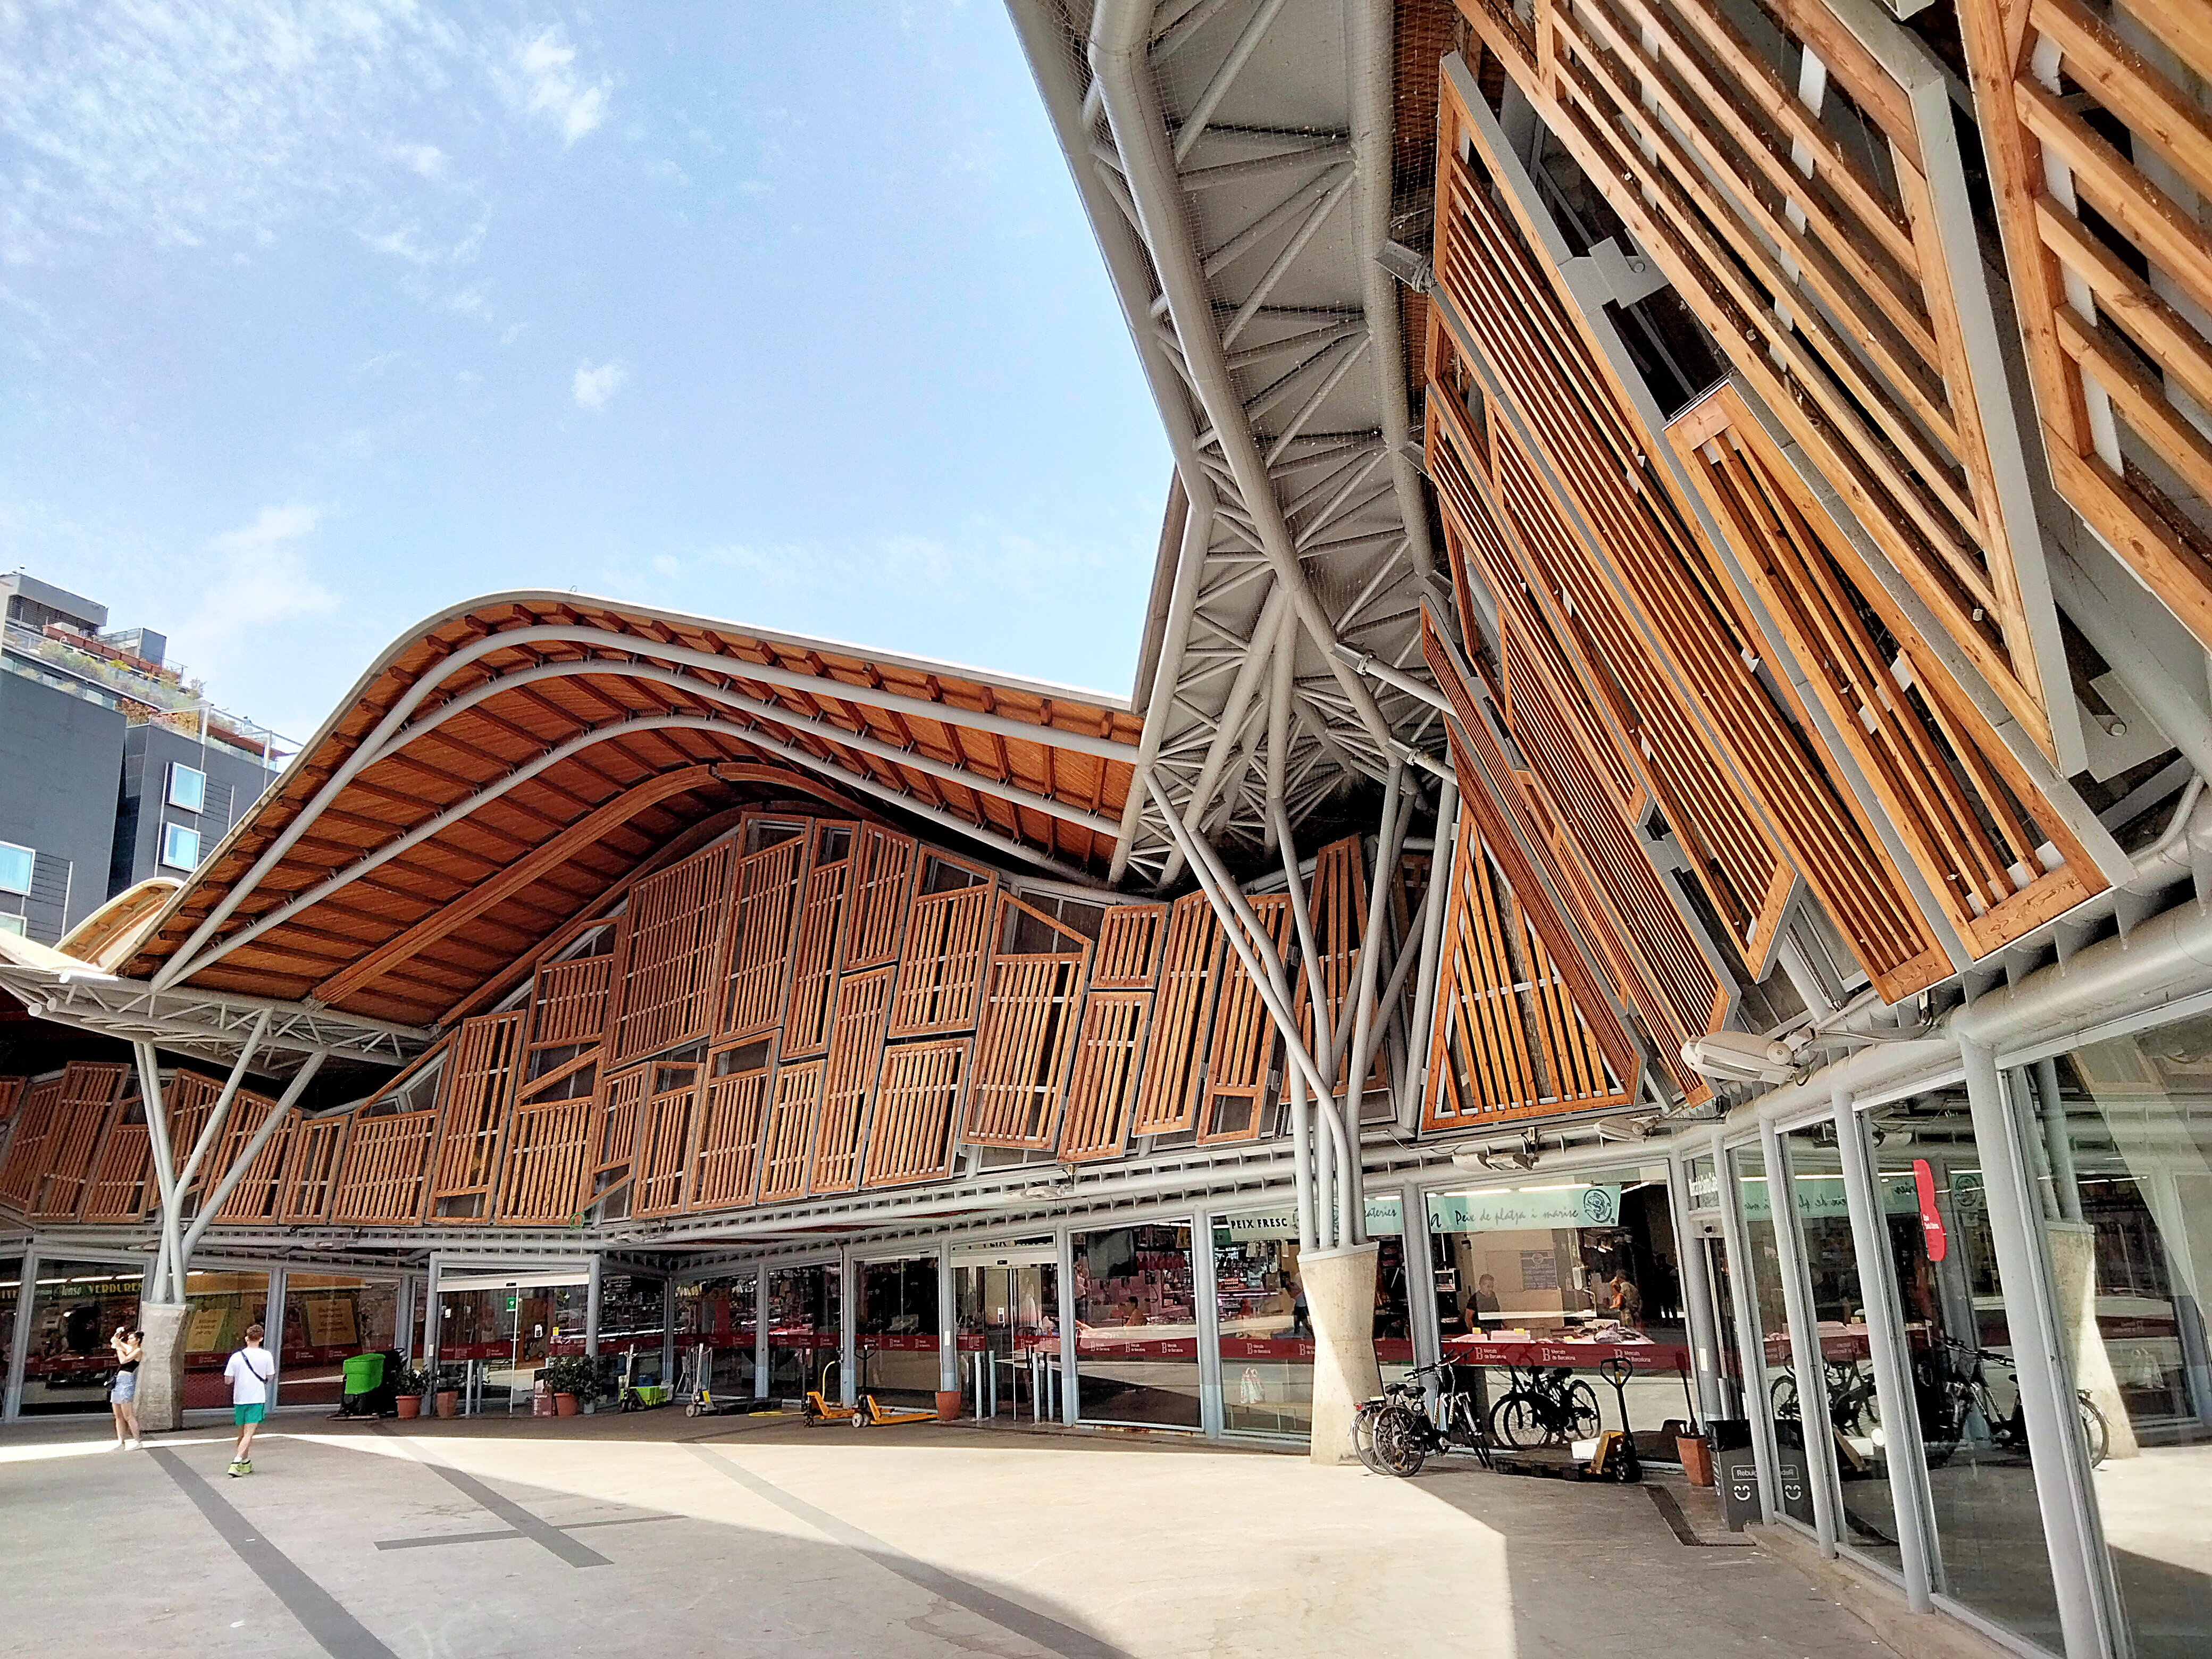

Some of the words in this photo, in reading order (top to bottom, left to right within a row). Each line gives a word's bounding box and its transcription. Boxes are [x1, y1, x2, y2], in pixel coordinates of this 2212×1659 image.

[1231, 1219, 1254, 1229] PEIX
[1257, 1217, 1288, 1228] FRESC
[1455, 1210, 1475, 1225] Peix
[1480, 1208, 1491, 1221] de
[1495, 1208, 1526, 1225] platja
[1530, 1209, 1537, 1218] i
[1544, 1206, 1579, 1218] marisc
